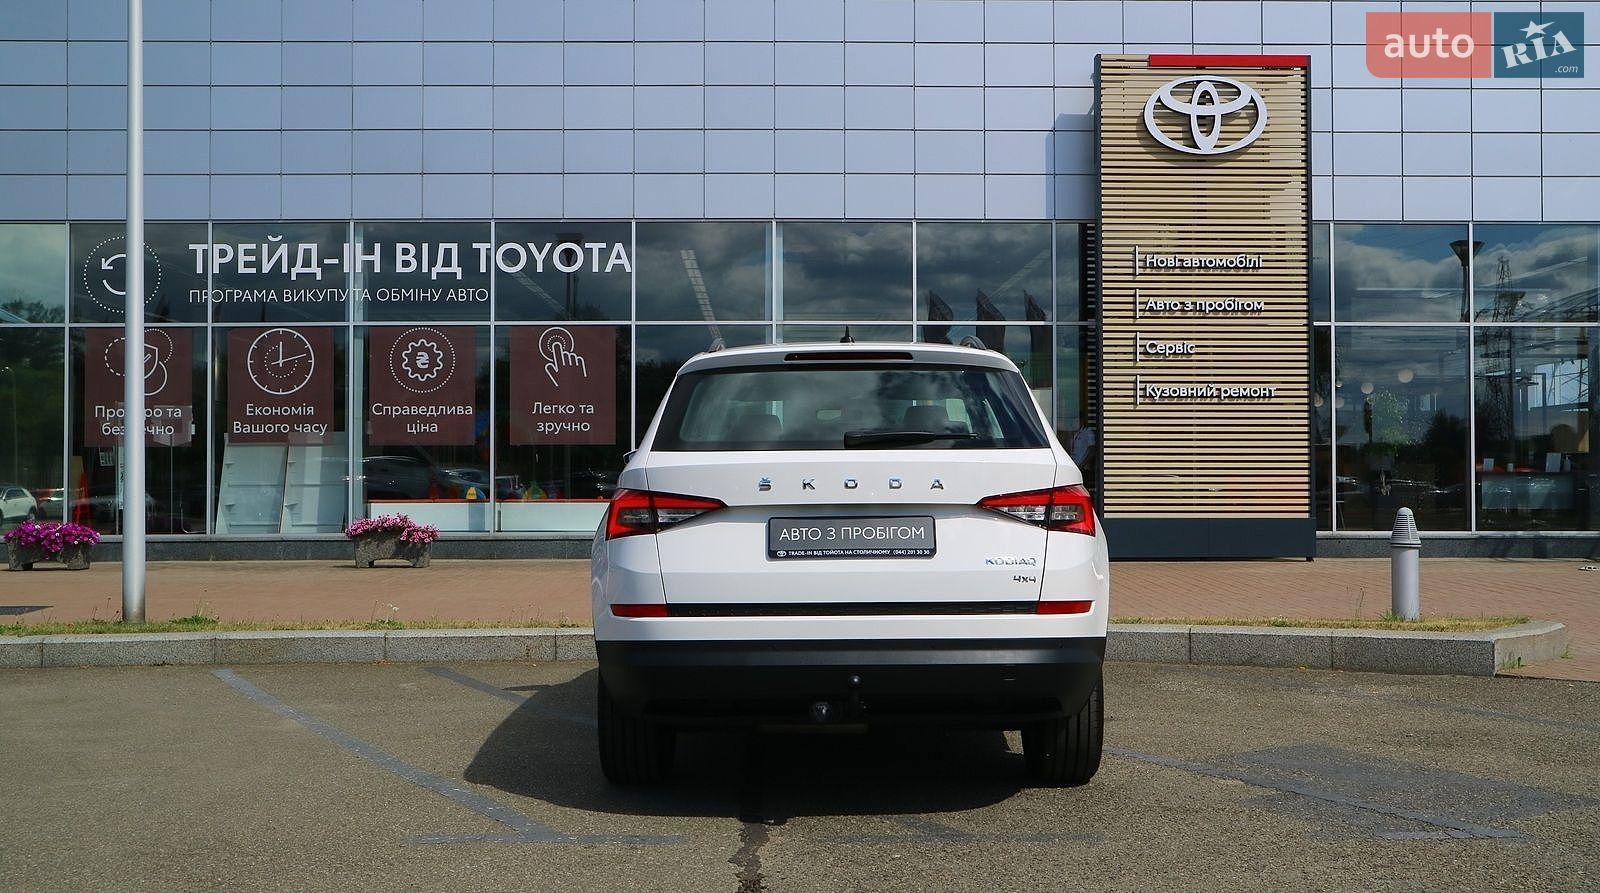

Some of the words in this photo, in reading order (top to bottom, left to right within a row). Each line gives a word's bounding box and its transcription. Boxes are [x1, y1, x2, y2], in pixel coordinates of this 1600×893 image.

[188, 235, 381, 281] ТРЕЙД-ІН
[395, 242, 463, 280] ВІД
[472, 242, 632, 273] TOYOTA
[1145, 254, 1179, 267] Нові
[1183, 254, 1263, 268] автомобілі
[188, 289, 278, 303] ПРОГРАМА
[283, 289, 347, 303] ВИКУПУ
[352, 289, 372, 302] ТА
[376, 288, 442, 302] ОБМІНУ
[446, 288, 489, 302] АВТО
[1145, 297, 1181, 311] Авто
[1196, 297, 1265, 313] пробігом
[1145, 340, 1197, 356] Сервіс
[1145, 383, 1218, 399] Кузовний
[1221, 386, 1277, 399] ремонт
[94, 405, 163, 421] Проро
[166, 408, 182, 418] та
[246, 403, 315, 416] Економія
[372, 403, 473, 418] Справедлива
[532, 402, 575, 414] Легко
[579, 404, 595, 414] та
[233, 421, 290, 433] Вашого
[294, 423, 328, 436] часу
[406, 420, 438, 434] ціна
[536, 422, 591, 435] зручно
[779, 527, 822, 541] АВТО
[841, 526, 925, 540] ПРОБІГОМ
